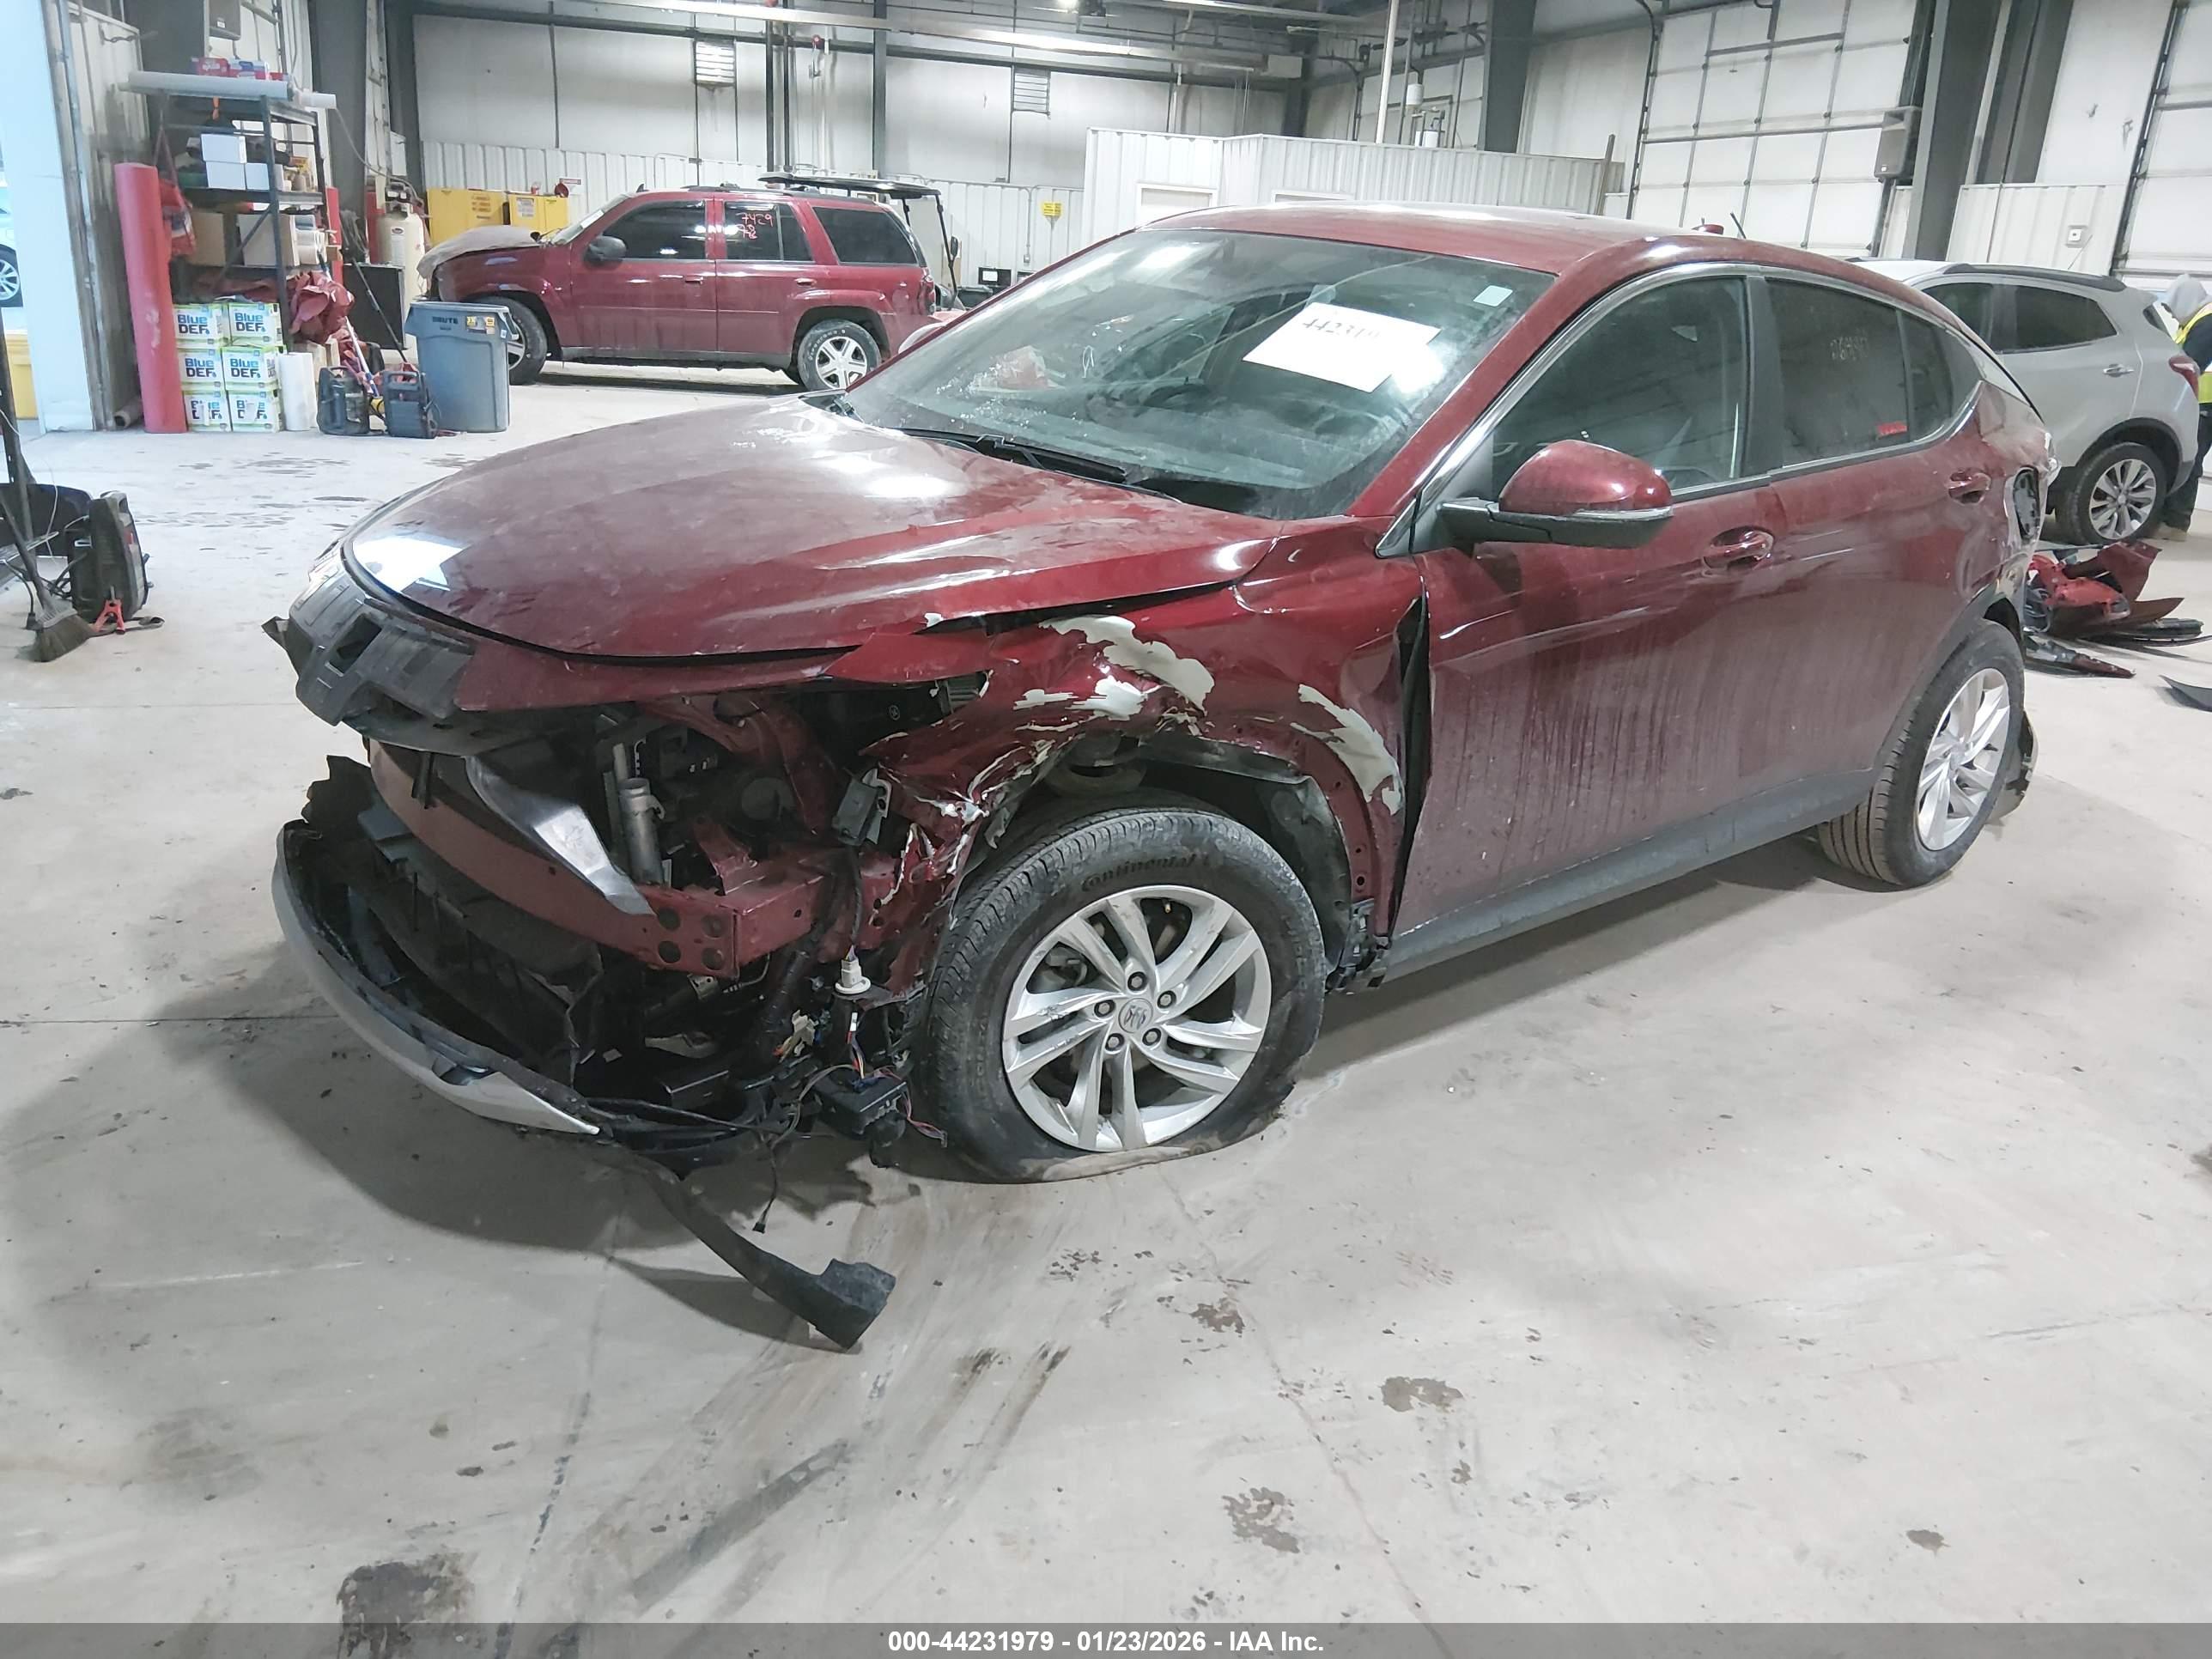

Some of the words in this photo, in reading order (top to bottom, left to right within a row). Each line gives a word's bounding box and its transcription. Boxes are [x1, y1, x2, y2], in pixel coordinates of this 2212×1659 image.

[178, 314, 208, 325] Blue
[234, 313, 264, 322] Blue
[179, 324, 209, 335] DEF
[235, 322, 264, 332] DEF
[185, 358, 215, 368] Blue
[230, 358, 260, 368] Blue
[185, 368, 215, 378] DEF
[231, 368, 260, 378] DEF
[191, 400, 220, 410] Be
[236, 400, 265, 409] Be
[191, 410, 221, 420] DF
[237, 410, 265, 420] DF
[1081, 853, 1197, 892] Continental
